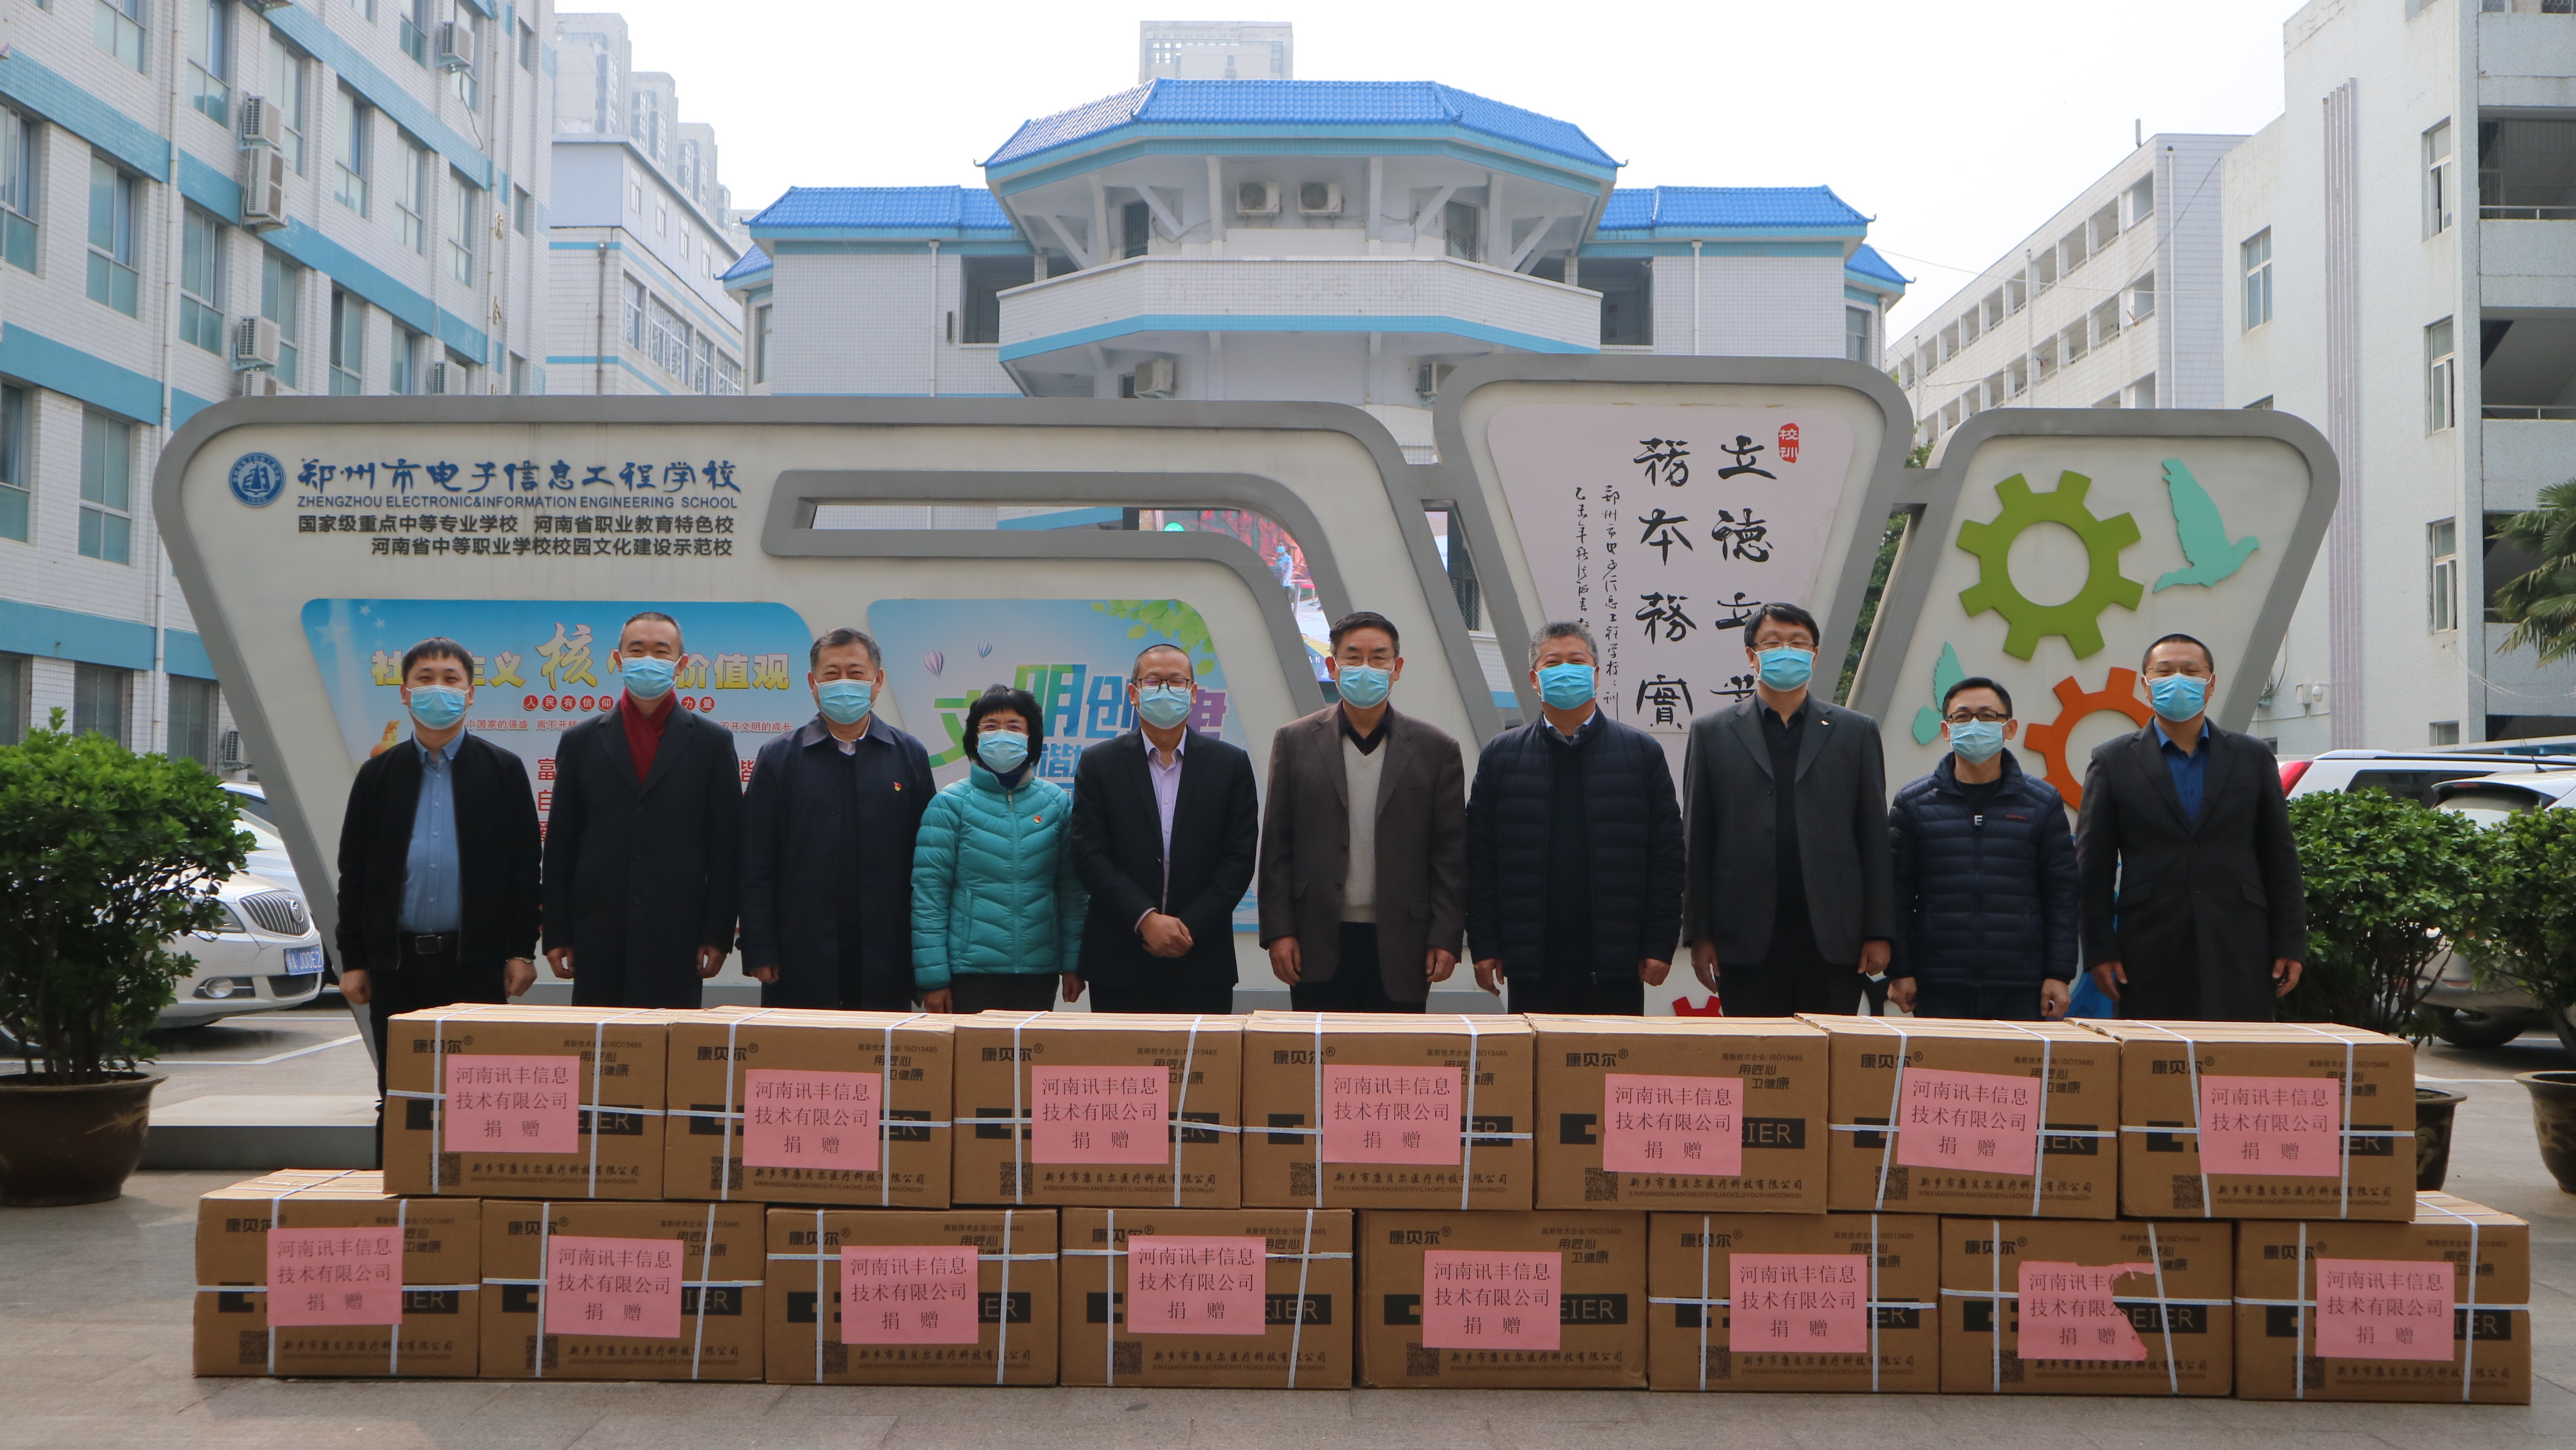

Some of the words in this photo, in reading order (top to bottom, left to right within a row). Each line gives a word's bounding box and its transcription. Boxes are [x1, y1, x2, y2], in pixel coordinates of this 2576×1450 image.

[1779, 429, 1799, 458] 校训
[298, 458, 741, 494] 郑州市电子信息工程学校
[298, 495, 382, 507] ZHENGZHOU
[386, 495, 576, 508] ELECTRONIC&INFORMATION
[581, 496, 674, 508] ENGINEERING
[681, 496, 738, 509] SCHOOL
[299, 515, 518, 533] 国家级重点中等专业学校
[534, 515, 733, 534] 河南省职业教育特色校
[371, 537, 732, 556] 河南省中等职业学校校园文化建设示范校
[456, 1066, 568, 1085] 河南讯丰信息
[1739, 1065, 1776, 1076] 用匠心
[756, 1082, 869, 1101] 河南讯丰信息
[1042, 1077, 1158, 1095] 河南讯丰信息
[1334, 1077, 1450, 1095] 河南讯丰信息
[1752, 1077, 1789, 1090] 卫健康
[1913, 1080, 2028, 1105] 河南讯丰信息
[456, 1092, 567, 1110] 技术有限公司
[1615, 1087, 1732, 1105] 河南讯丰信息
[2212, 1088, 2329, 1107] 河南讯丰信息
[756, 1107, 868, 1127] 技术有限公司
[1042, 1103, 1157, 1121] 技术有限公司
[1334, 1103, 1449, 1121] 技术有限公司
[1912, 1105, 2026, 1131] 技术有限公司
[1615, 1113, 1730, 1132] 技术有限公司
[2212, 1114, 2328, 1132] 技术有限公司
[1629, 1178, 1802, 1190] 新乡市康贝尔医疗科技有限公司
[278, 1237, 391, 1257] 河南讯丰信息
[961, 1235, 998, 1246] 用匠心
[1558, 1239, 1596, 1250] 用匠心
[558, 1248, 671, 1269] 河南讯丰信息
[1138, 1247, 1254, 1266] 河南讯丰信息
[1571, 1251, 1609, 1263] 卫健康
[278, 1263, 390, 1284] 技术有限公司
[852, 1257, 967, 1276] 河南讯丰信息
[1435, 1262, 1550, 1281] 河南讯丰信息
[1741, 1265, 1856, 1284] 河南讯丰信息
[558, 1274, 670, 1294] 技术有限公司
[1139, 1273, 1253, 1291] 技术有限公司
[2327, 1272, 2443, 1291] 河南讯丰信息
[852, 1283, 966, 1302] 技术有限公司
[1435, 1288, 1549, 1306] 技术有限公司
[1741, 1291, 1855, 1310] 技术有限公司
[2327, 1297, 2442, 1317] 技术有限公司
[1451, 1352, 1622, 1363] 新乡市康贝尔医疗科技有限公司
